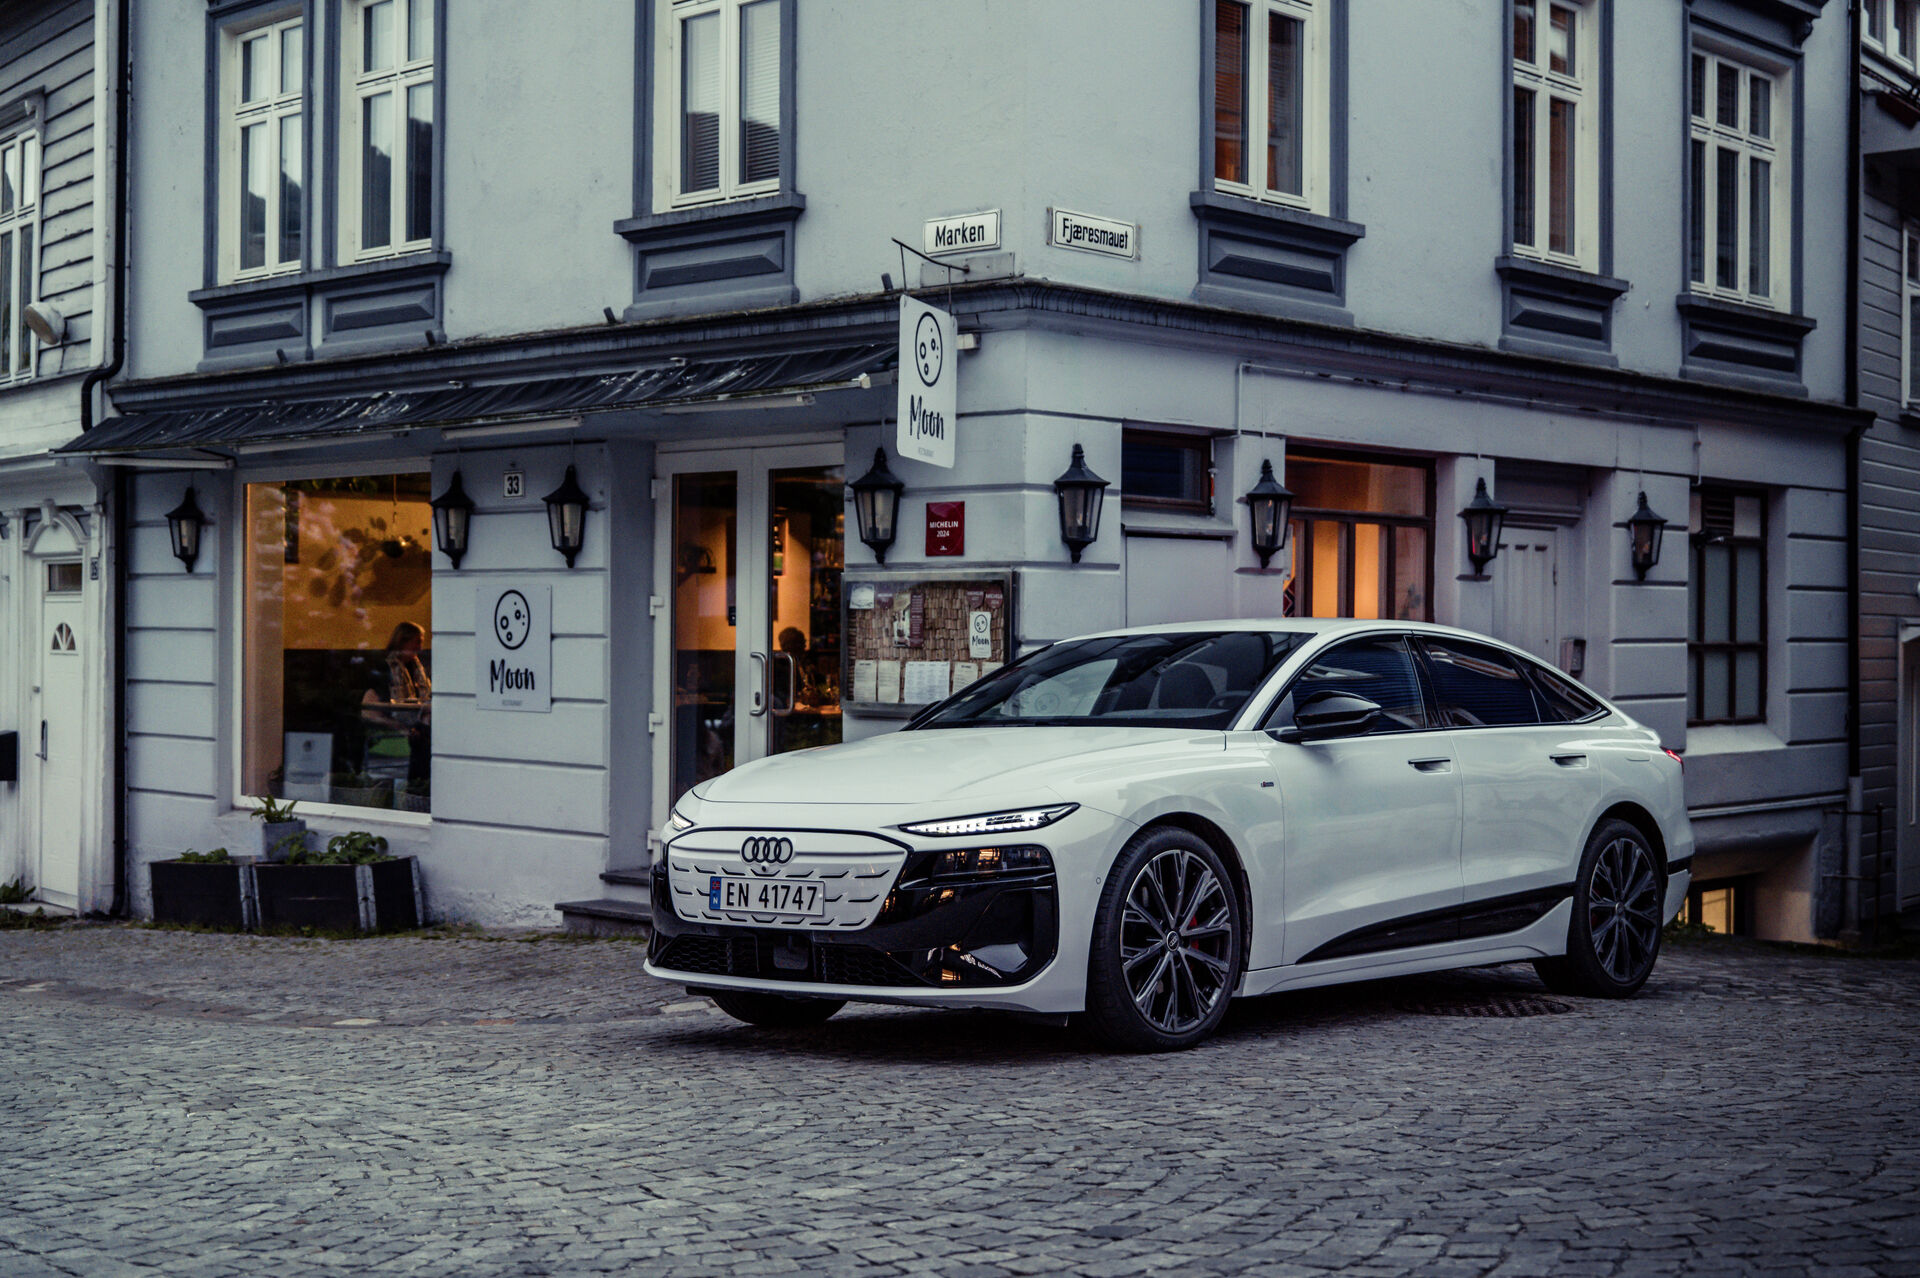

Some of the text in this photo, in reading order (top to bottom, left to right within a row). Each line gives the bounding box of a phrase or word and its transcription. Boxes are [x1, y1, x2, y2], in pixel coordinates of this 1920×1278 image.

[935, 222, 985, 247] Marken
[1062, 217, 1129, 250] Fjæresmauet
[909, 394, 944, 441] Moon
[507, 475, 520, 495] 33
[929, 520, 959, 529] MICHELIN
[936, 530, 950, 538] 2024
[971, 635, 990, 647] Moon
[490, 659, 536, 695] Moon
[712, 896, 719, 905] N
[726, 882, 818, 911] EN 41747
